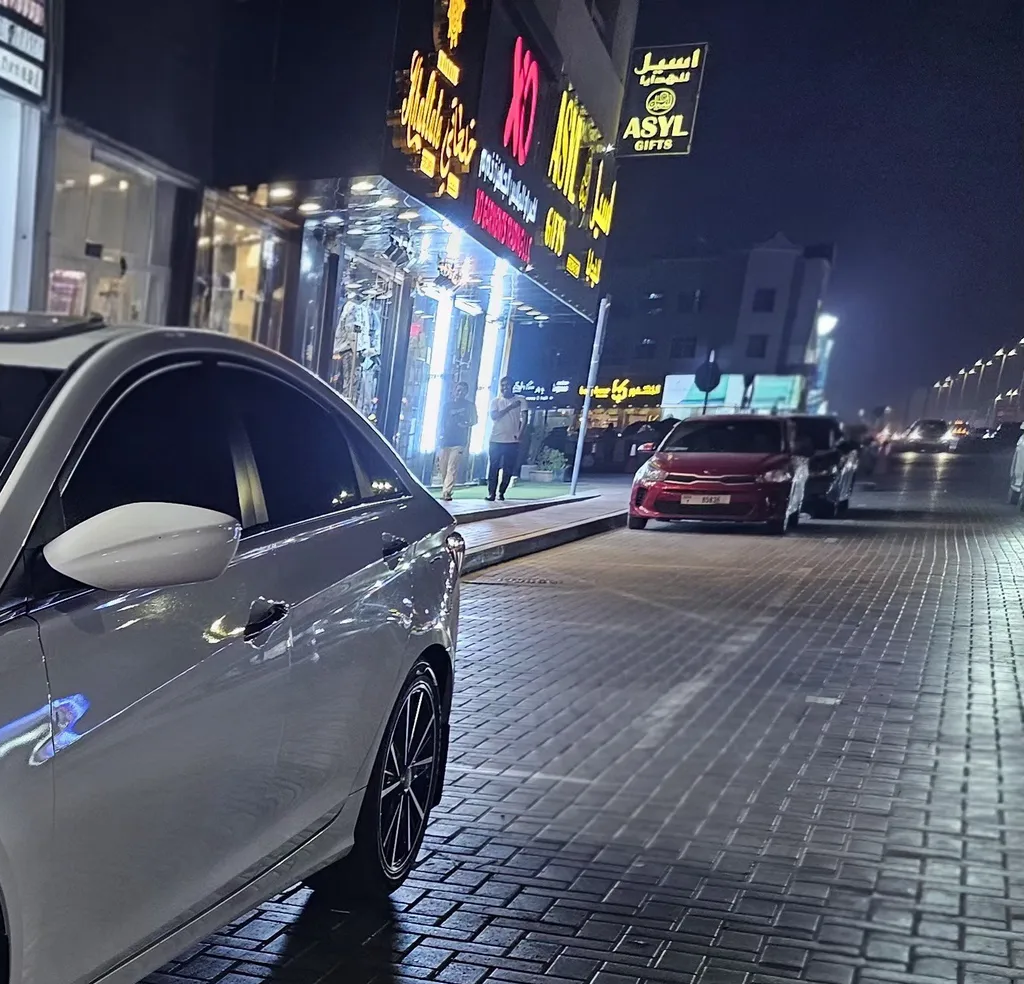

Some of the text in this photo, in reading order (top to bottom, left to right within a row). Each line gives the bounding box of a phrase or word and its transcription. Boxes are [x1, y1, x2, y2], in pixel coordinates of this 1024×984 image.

[622, 114, 689, 140] ASYL
[548, 90, 576, 205] ASYL
[634, 139, 673, 151] GIFTS
